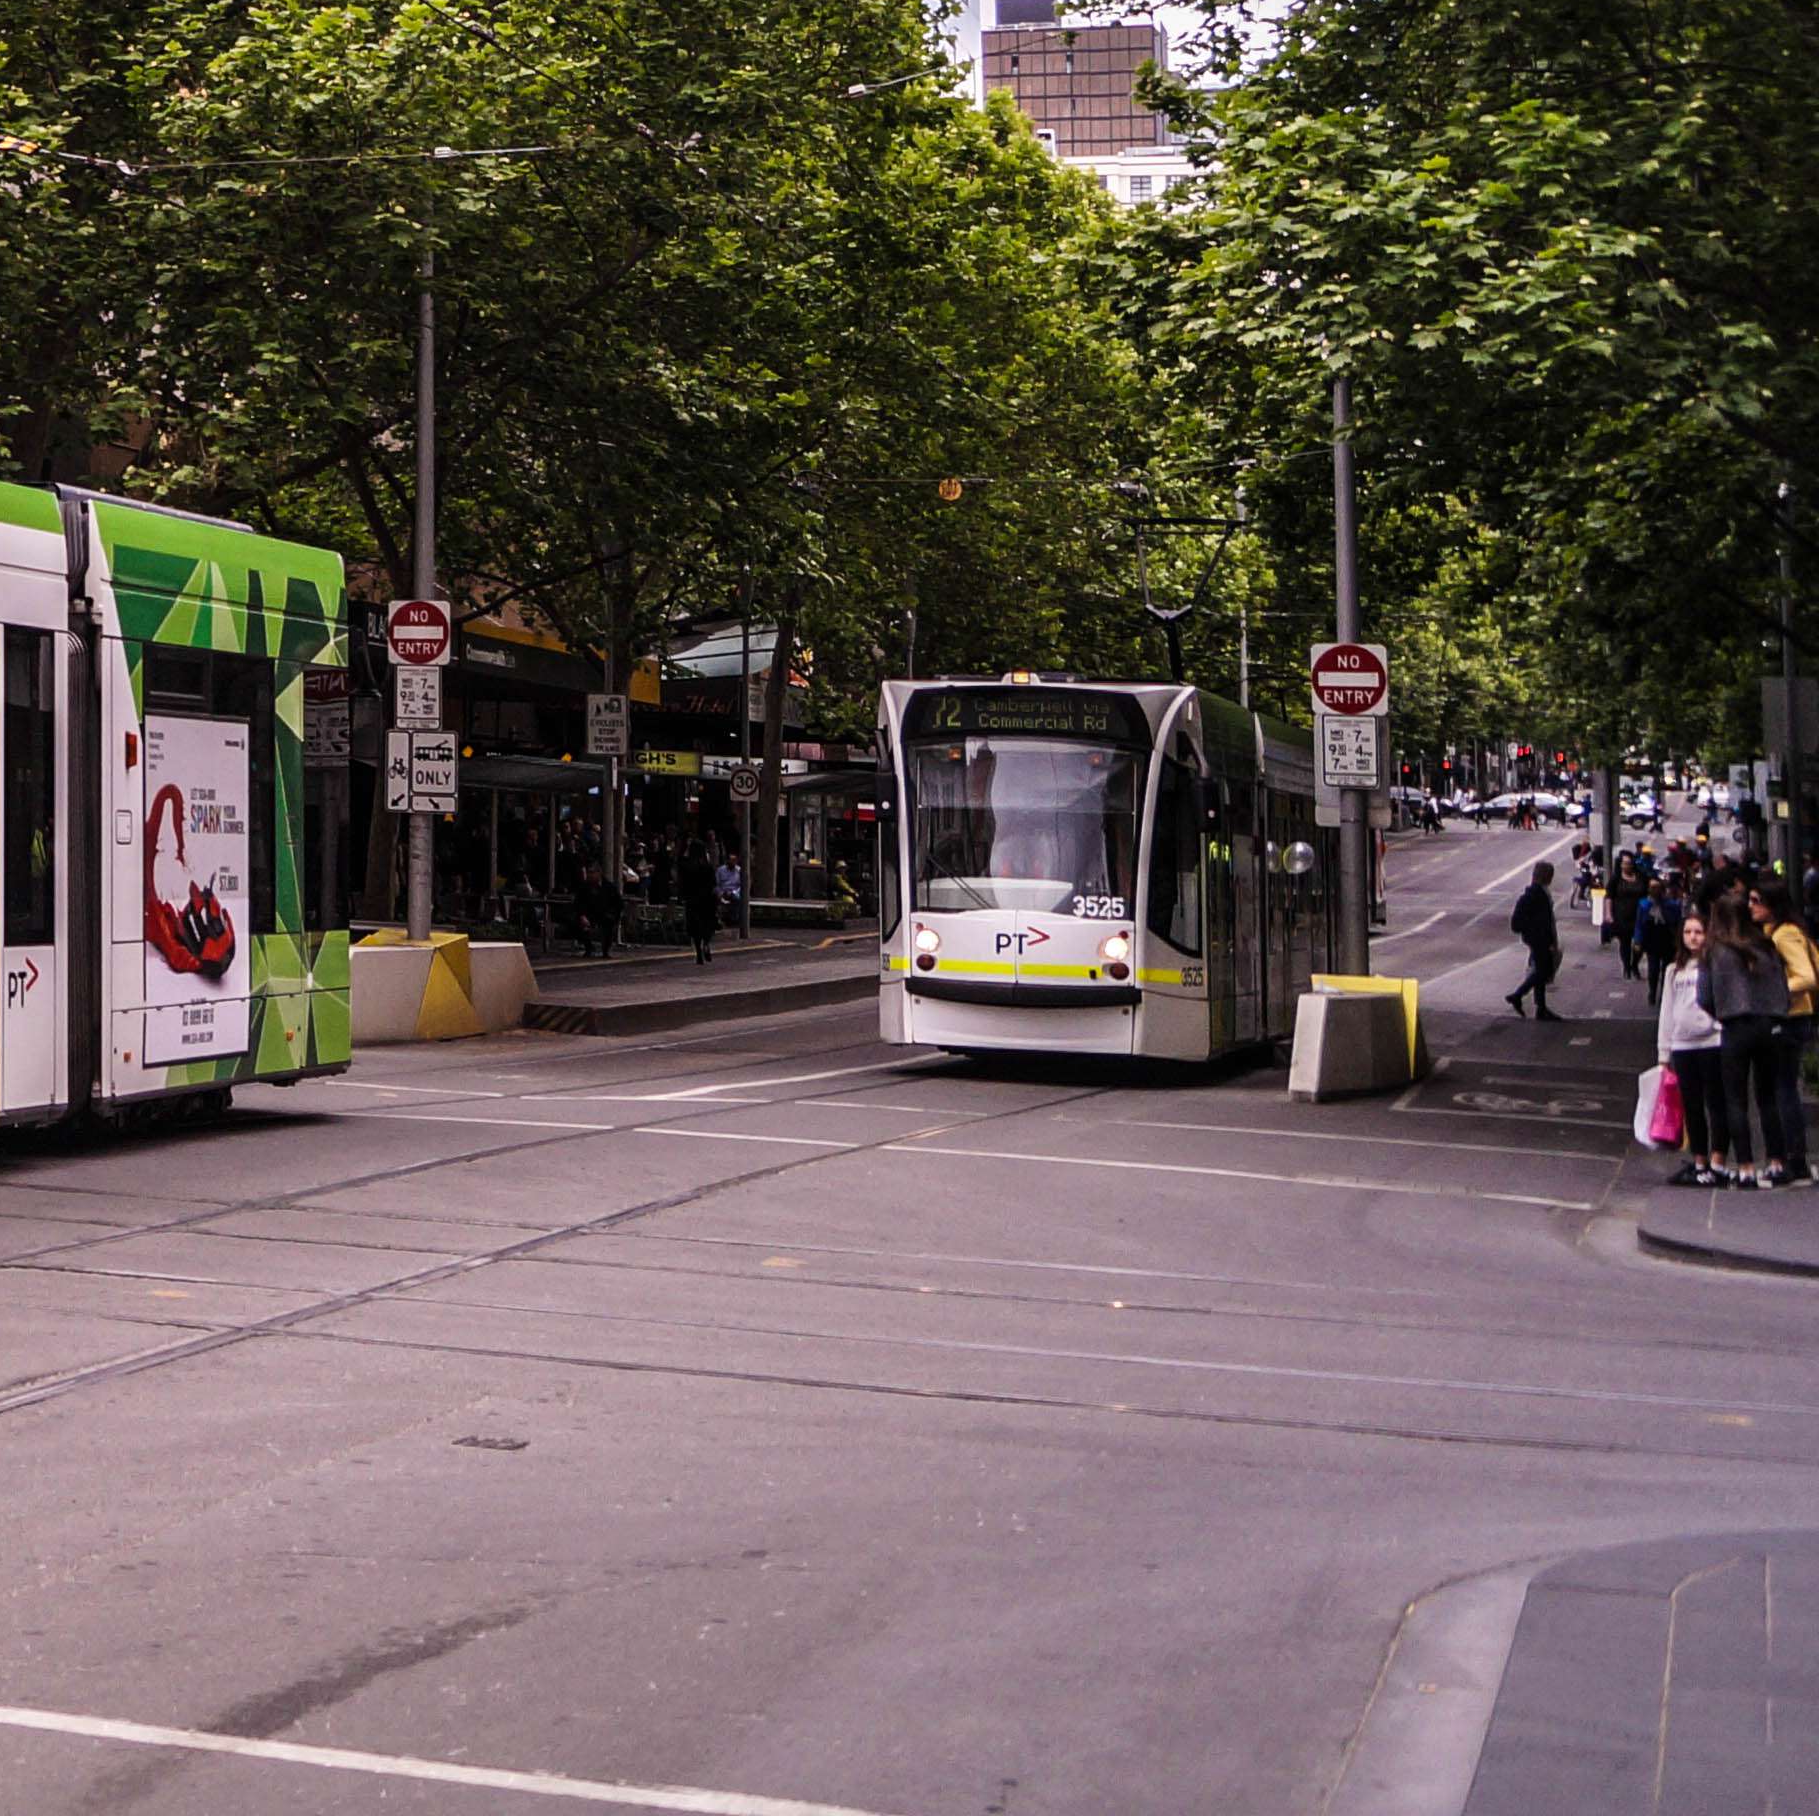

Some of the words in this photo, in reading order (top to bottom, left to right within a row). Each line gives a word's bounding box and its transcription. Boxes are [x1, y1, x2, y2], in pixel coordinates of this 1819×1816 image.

[409, 610, 428, 622] NO
[398, 642, 440, 655] ENTRY
[1337, 655, 1360, 668] NO
[1324, 690, 1375, 704] ENTRY
[979, 714, 1073, 729] Commercial
[1084, 716, 1107, 730] Rd
[1353, 730, 1362, 742] 7
[1355, 744, 1363, 756] 4
[635, 751, 676, 765] GH'S
[416, 771, 451, 785] ONLY
[736, 776, 754, 789] 30
[190, 804, 223, 834] SPARK
[1072, 896, 1125, 918] 3525
[996, 933, 1028, 955] PT
[1181, 968, 1203, 987] 3525
